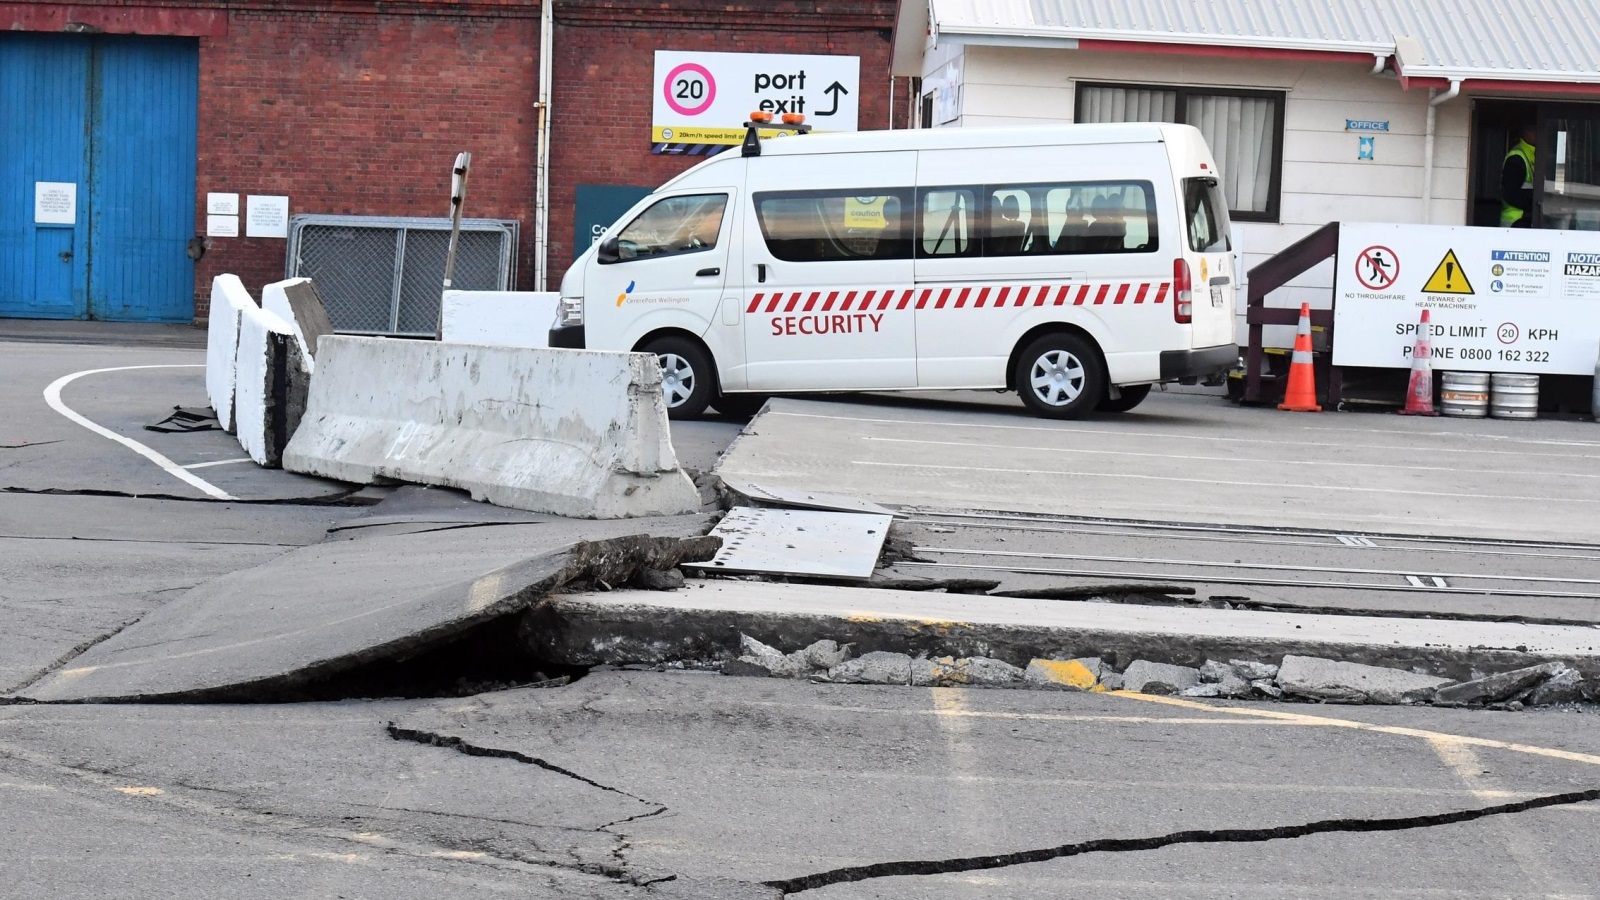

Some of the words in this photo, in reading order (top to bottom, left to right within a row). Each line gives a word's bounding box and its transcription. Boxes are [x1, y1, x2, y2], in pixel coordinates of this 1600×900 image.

[676, 79, 703, 99] 20
[755, 70, 806, 93] port
[759, 96, 806, 114] exit
[1350, 121, 1384, 130] OFFICE
[1503, 252, 1549, 261] ATTENTION
[771, 314, 884, 336] SECURITY
[1450, 325, 1487, 338] LIMIT
[1501, 329, 1515, 338] 20
[1528, 329, 1558, 340] KPH
[1403, 346, 1454, 359] PNE
[1460, 348, 1492, 360] 0800
[1498, 350, 1520, 361] 162
[1526, 351, 1549, 362] 322
